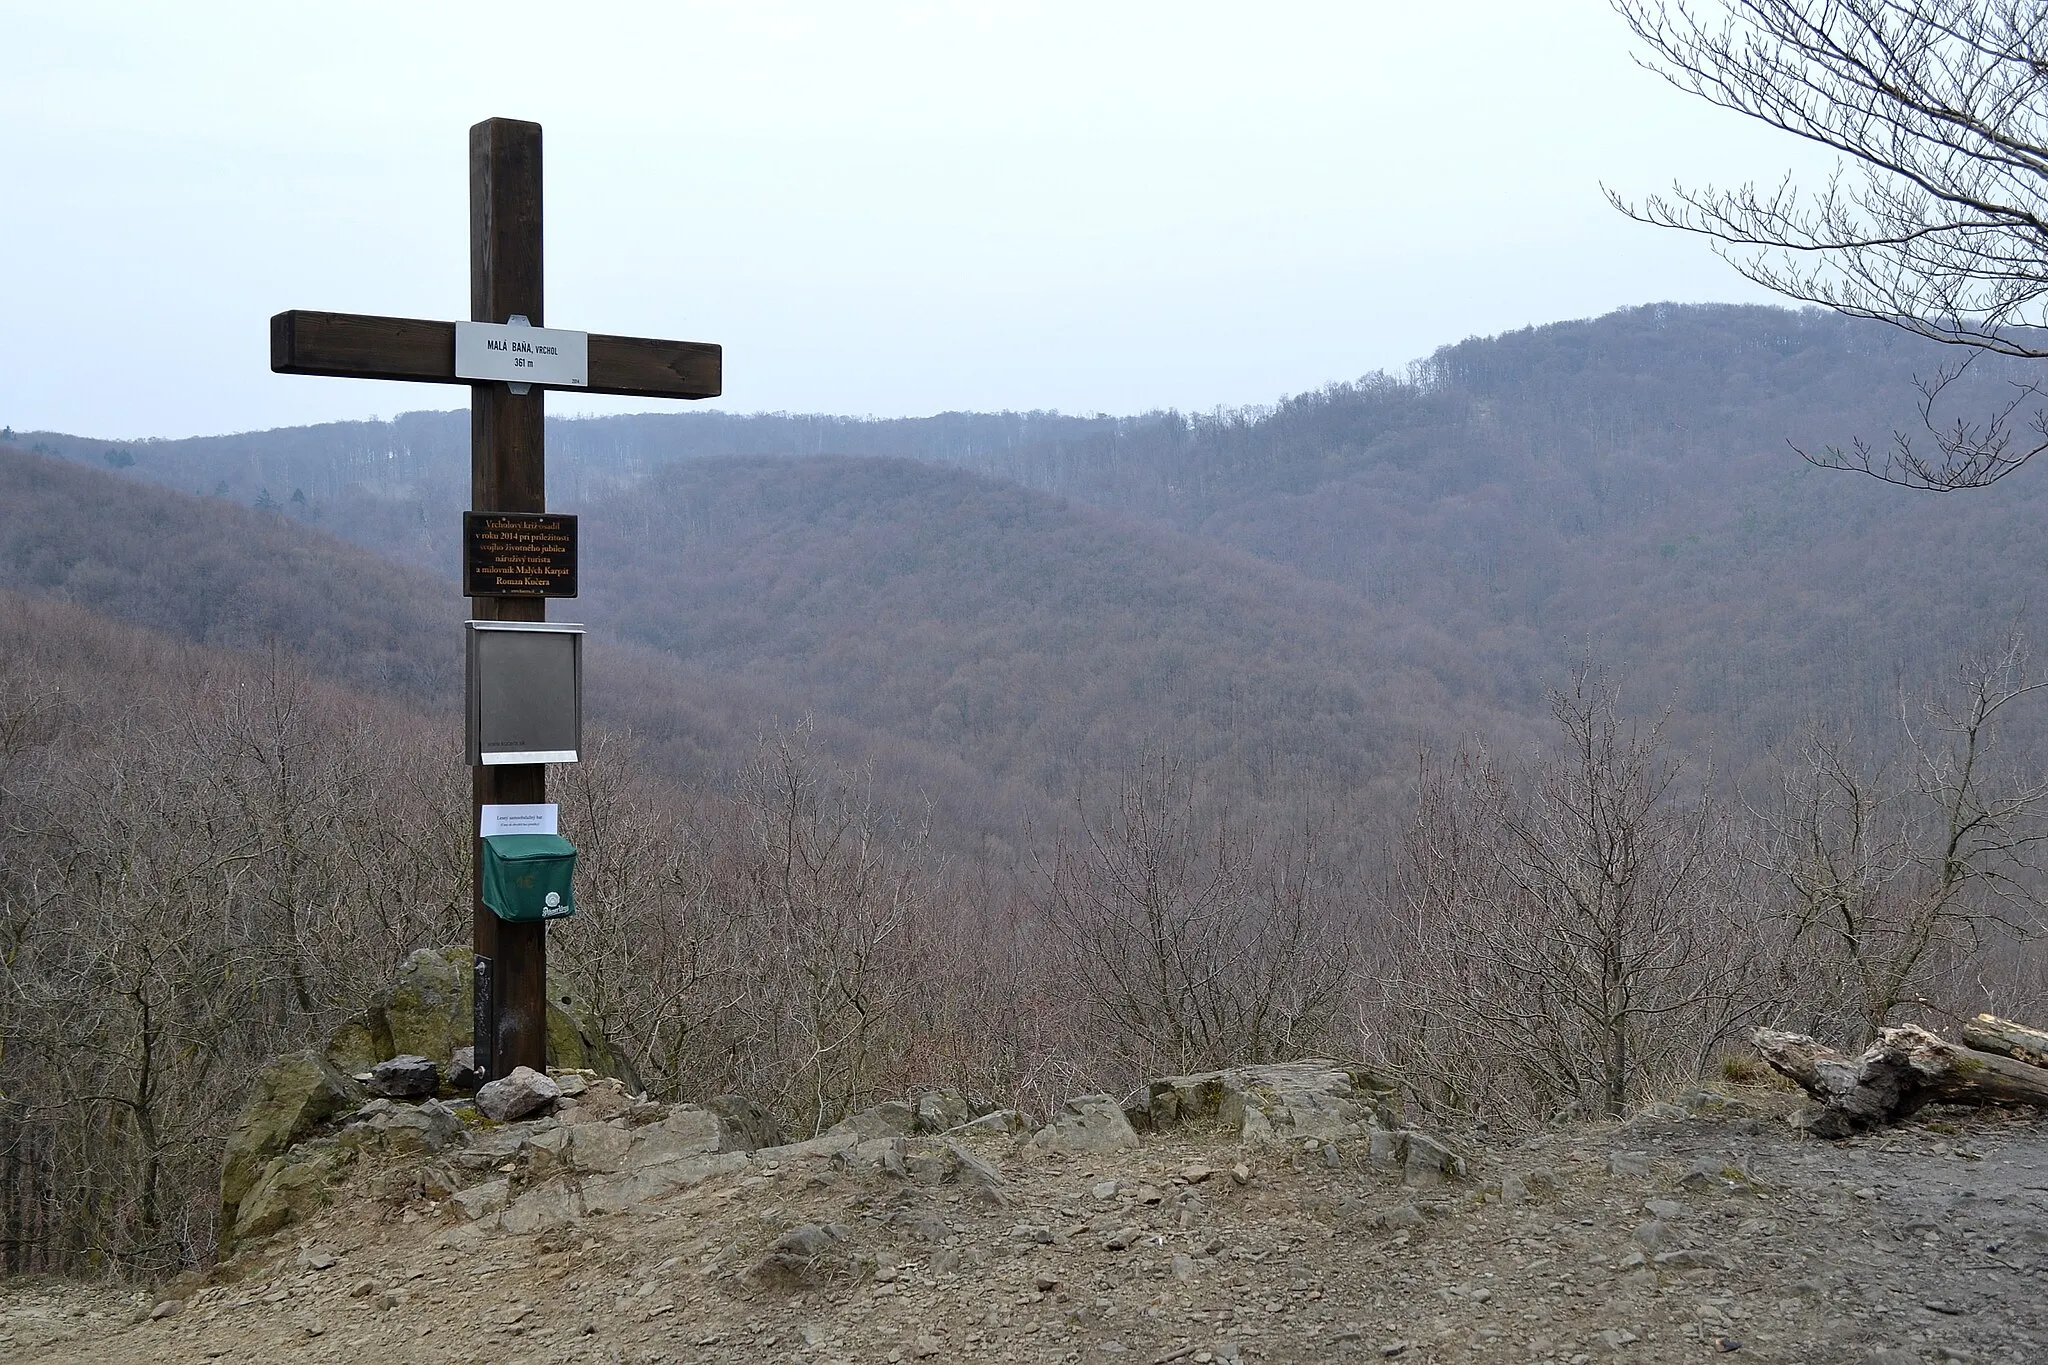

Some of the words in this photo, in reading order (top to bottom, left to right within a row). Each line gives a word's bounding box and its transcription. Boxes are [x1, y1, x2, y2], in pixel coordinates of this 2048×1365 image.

[487, 339, 508, 351] MALÁ
[512, 340, 534, 354] BAŇA,
[535, 345, 558, 356] VRCHOL
[514, 358, 526, 367] 361
[527, 360, 534, 368] m
[486, 519, 522, 531] Vrcholový
[481, 532, 499, 540] roku
[500, 532, 518, 540] 2014
[519, 533, 530, 542] pri
[541, 544, 566, 554] jubilea
[527, 555, 551, 563] turista
[515, 565, 543, 576] Malých
[496, 576, 523, 585] Roman
[524, 576, 550, 586] Kučera
